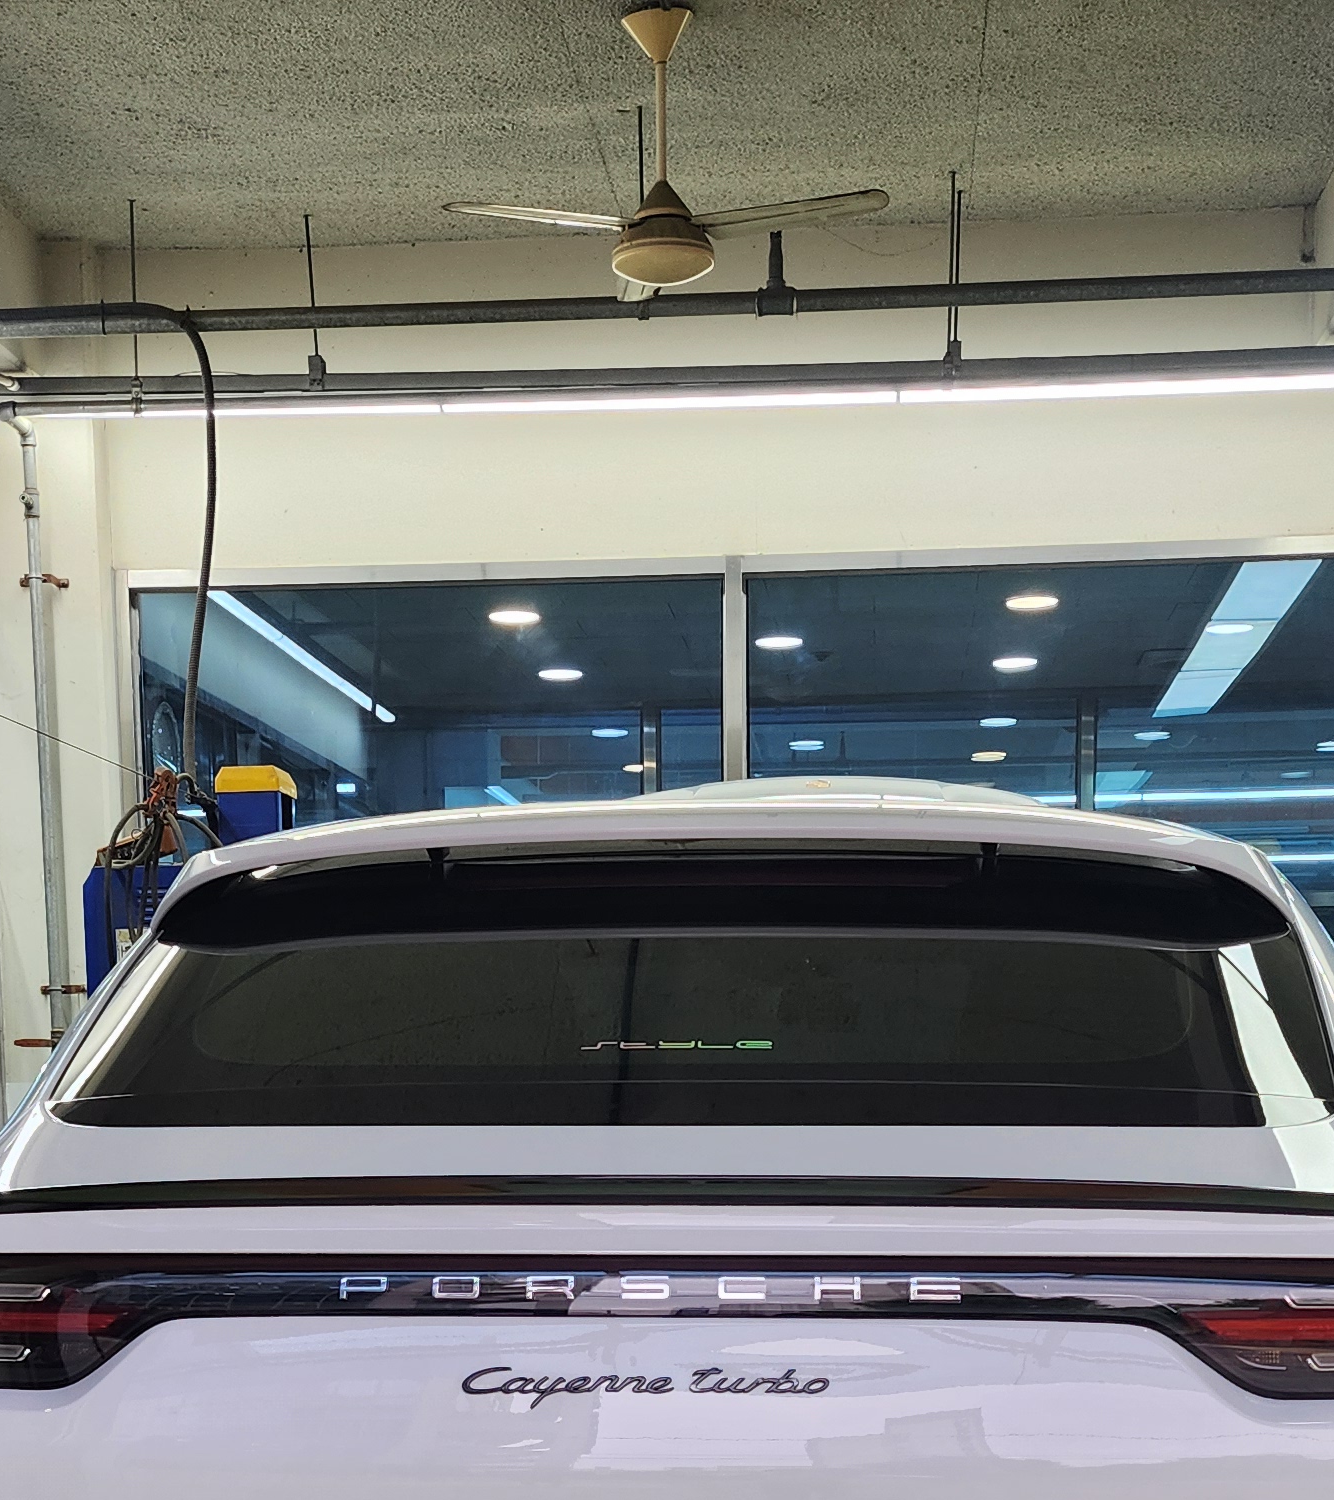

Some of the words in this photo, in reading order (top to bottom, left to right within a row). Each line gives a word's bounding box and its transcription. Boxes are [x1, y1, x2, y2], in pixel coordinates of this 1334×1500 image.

[339, 1275, 963, 1303] PORSCHE
[462, 1366, 675, 1409] Cayenne
[688, 1368, 831, 1395] turbo
